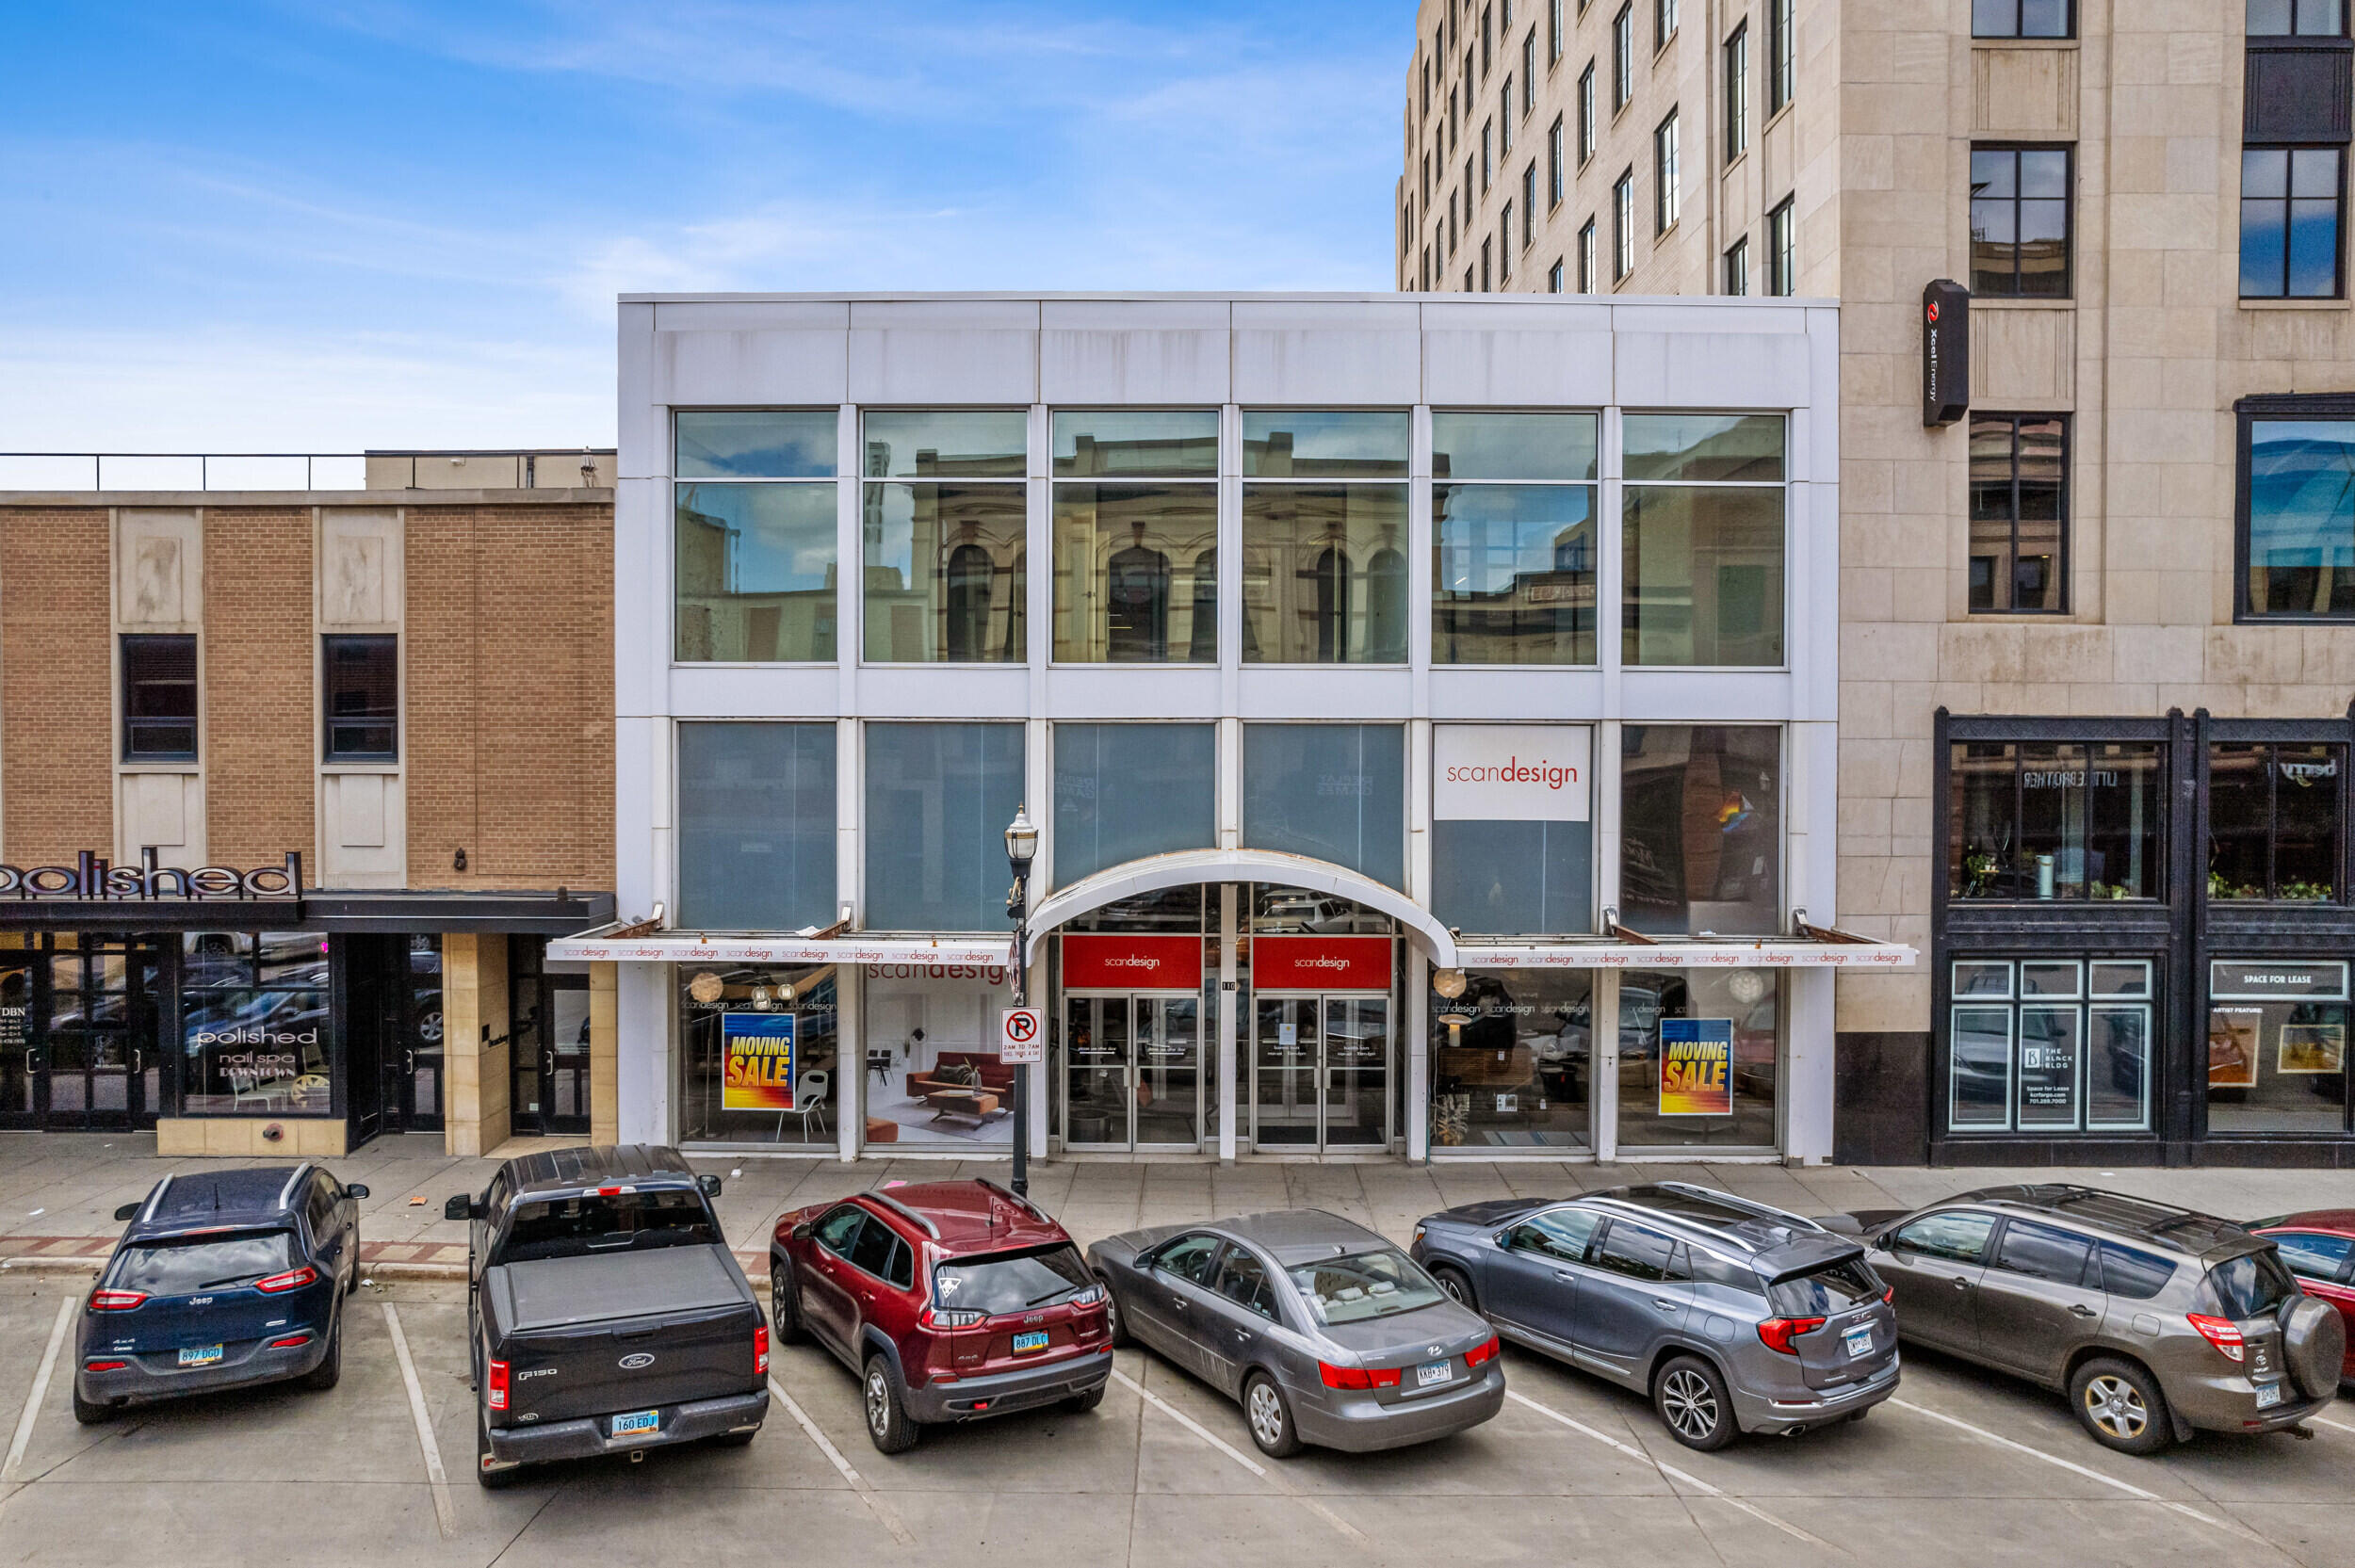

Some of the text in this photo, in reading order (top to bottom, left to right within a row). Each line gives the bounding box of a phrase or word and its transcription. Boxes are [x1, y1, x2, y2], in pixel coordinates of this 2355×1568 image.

[1929, 360, 1938, 402] Energy
[1447, 756, 1578, 790] scandesign
[564, 946, 609, 959] scandesign
[618, 946, 663, 959] scandesign
[673, 946, 718, 959] scandesign
[726, 946, 772, 960] scandesign
[782, 947, 828, 961] scandesign
[836, 947, 884, 962] scandesign
[891, 949, 938, 962] scandesign
[947, 950, 994, 963] scandesign
[1472, 953, 1519, 965] scandesign
[1527, 953, 1573, 965] scandesign
[1583, 953, 1628, 965] scandesign
[1636, 952, 1683, 965] scandesign
[1693, 952, 1739, 964] scandesign
[1747, 951, 1794, 964] scandesign
[1801, 951, 1847, 964] scandesign
[1856, 951, 1902, 964] scandesign
[1106, 953, 1160, 969] scandesign
[1294, 954, 1349, 970] scandesign
[869, 964, 1009, 985] scandesig
[2288, 976, 2312, 984] LEASE
[1222, 982, 1236, 991] 110
[0, 1008, 25, 1016] DBN
[197, 1026, 317, 1048] polished
[731, 1036, 790, 1056] MOVING
[1668, 1042, 1728, 1060] MOVING
[219, 1051, 296, 1065] nail spa
[219, 1067, 296, 1077] DOWNTOWN
[726, 1056, 790, 1087] SALE
[1664, 1060, 1728, 1092] SALE
[189, 1297, 213, 1305] Jeep
[1023, 1315, 1044, 1324] Jeep
[626, 1357, 647, 1366] Ford
[618, 1419, 635, 1431] 160
[637, 1415, 655, 1429] EDJ
